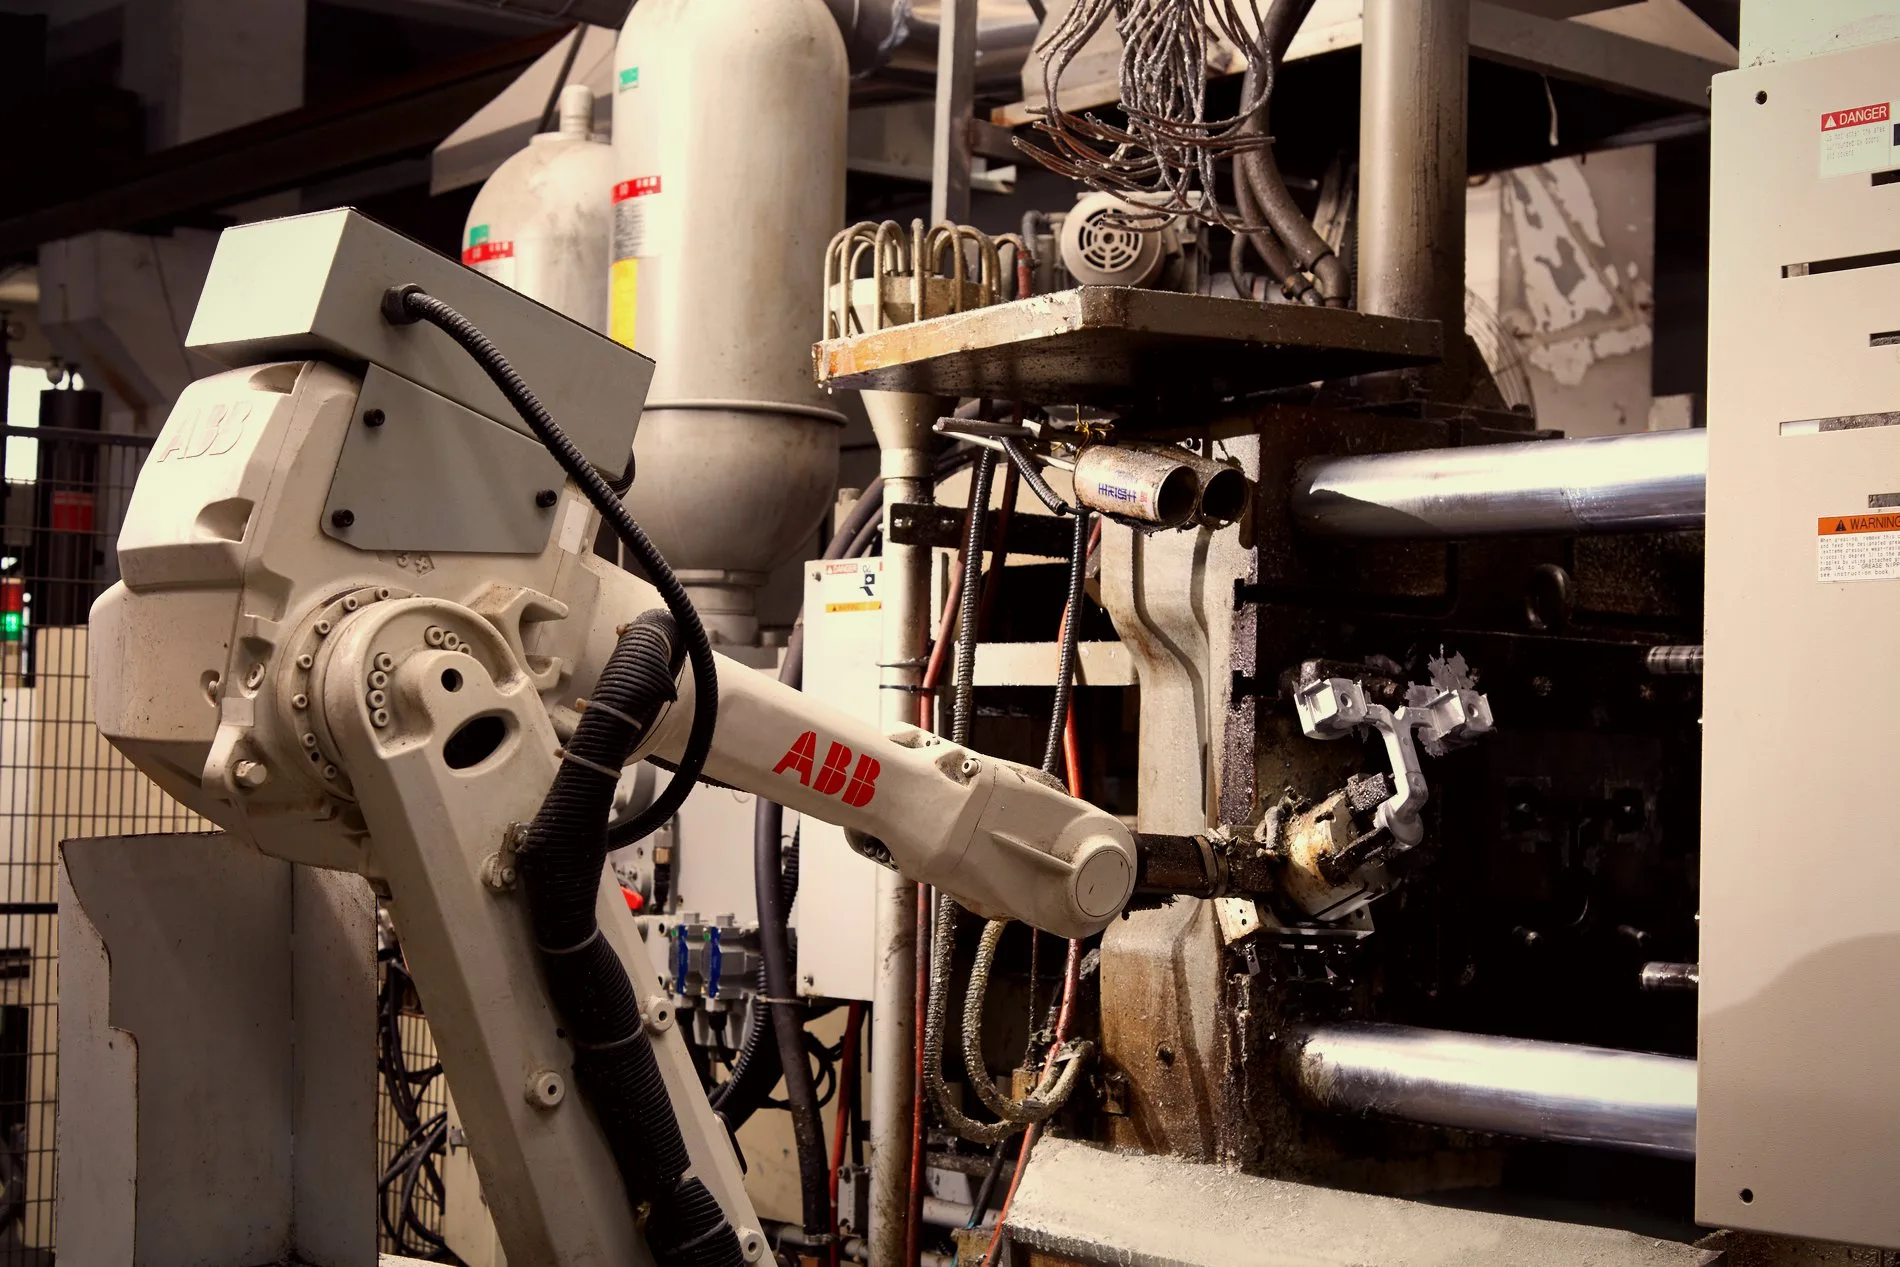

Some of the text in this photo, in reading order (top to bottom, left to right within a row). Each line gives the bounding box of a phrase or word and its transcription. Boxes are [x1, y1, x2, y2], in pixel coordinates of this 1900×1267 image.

[1840, 105, 1887, 125] DANGER
[157, 400, 253, 464] ABB
[1850, 516, 1900, 530] WARNING
[771, 731, 881, 808] ABB
